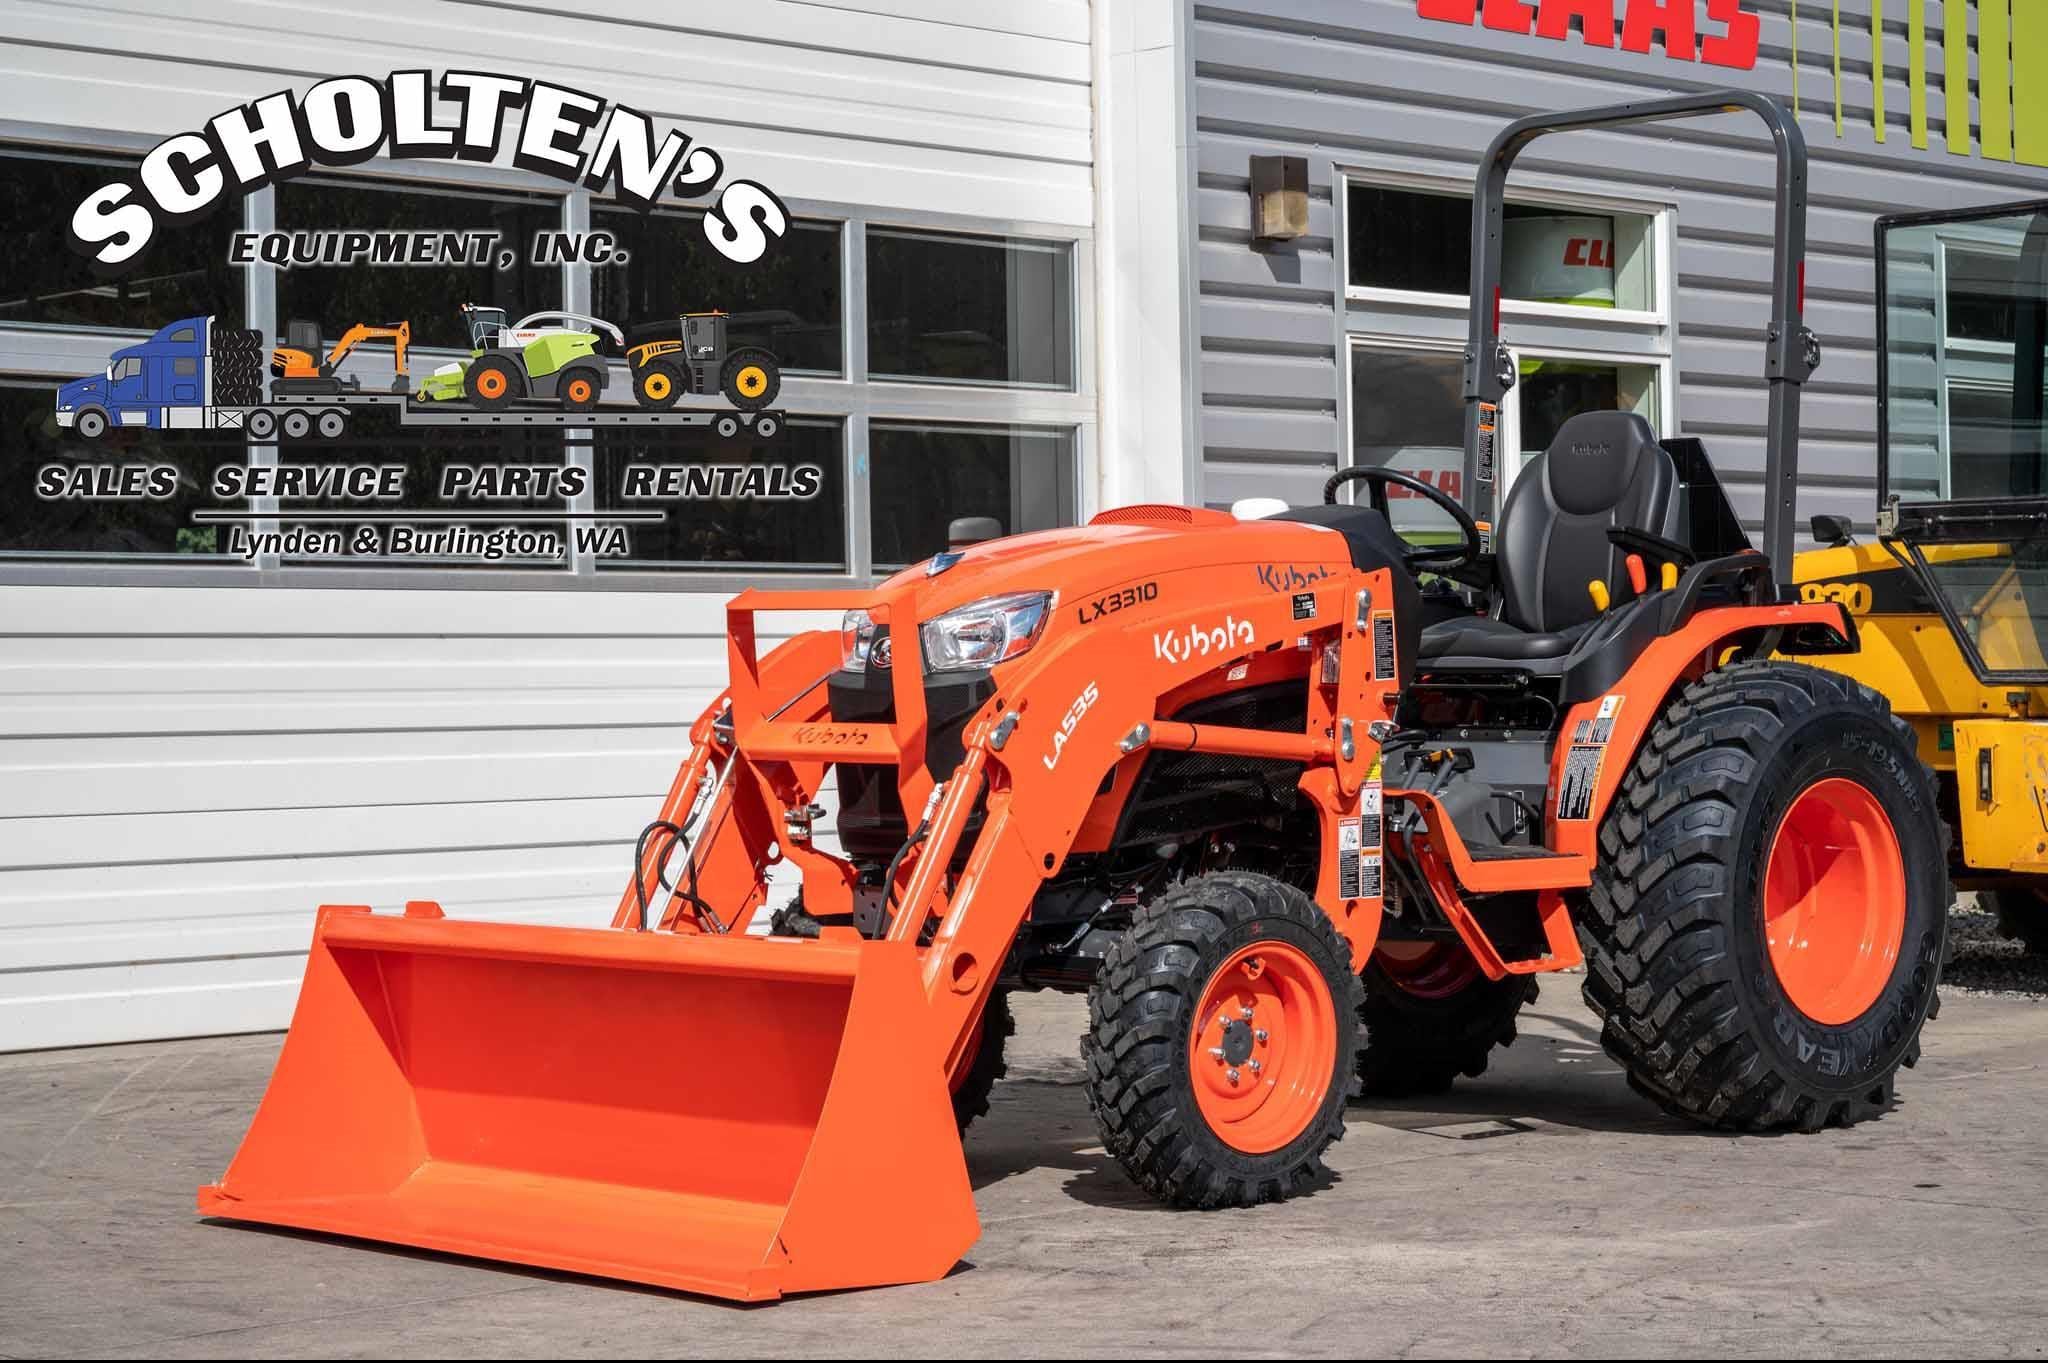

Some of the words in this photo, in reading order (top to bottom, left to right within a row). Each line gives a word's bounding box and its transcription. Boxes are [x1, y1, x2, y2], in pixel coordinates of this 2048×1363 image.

[1257, 564, 1337, 593] Kubot
[1078, 581, 1159, 625] LX3310
[1154, 615, 1256, 664] Kubota
[792, 726, 869, 746] Kubota
[1043, 680, 1099, 770] LA535
